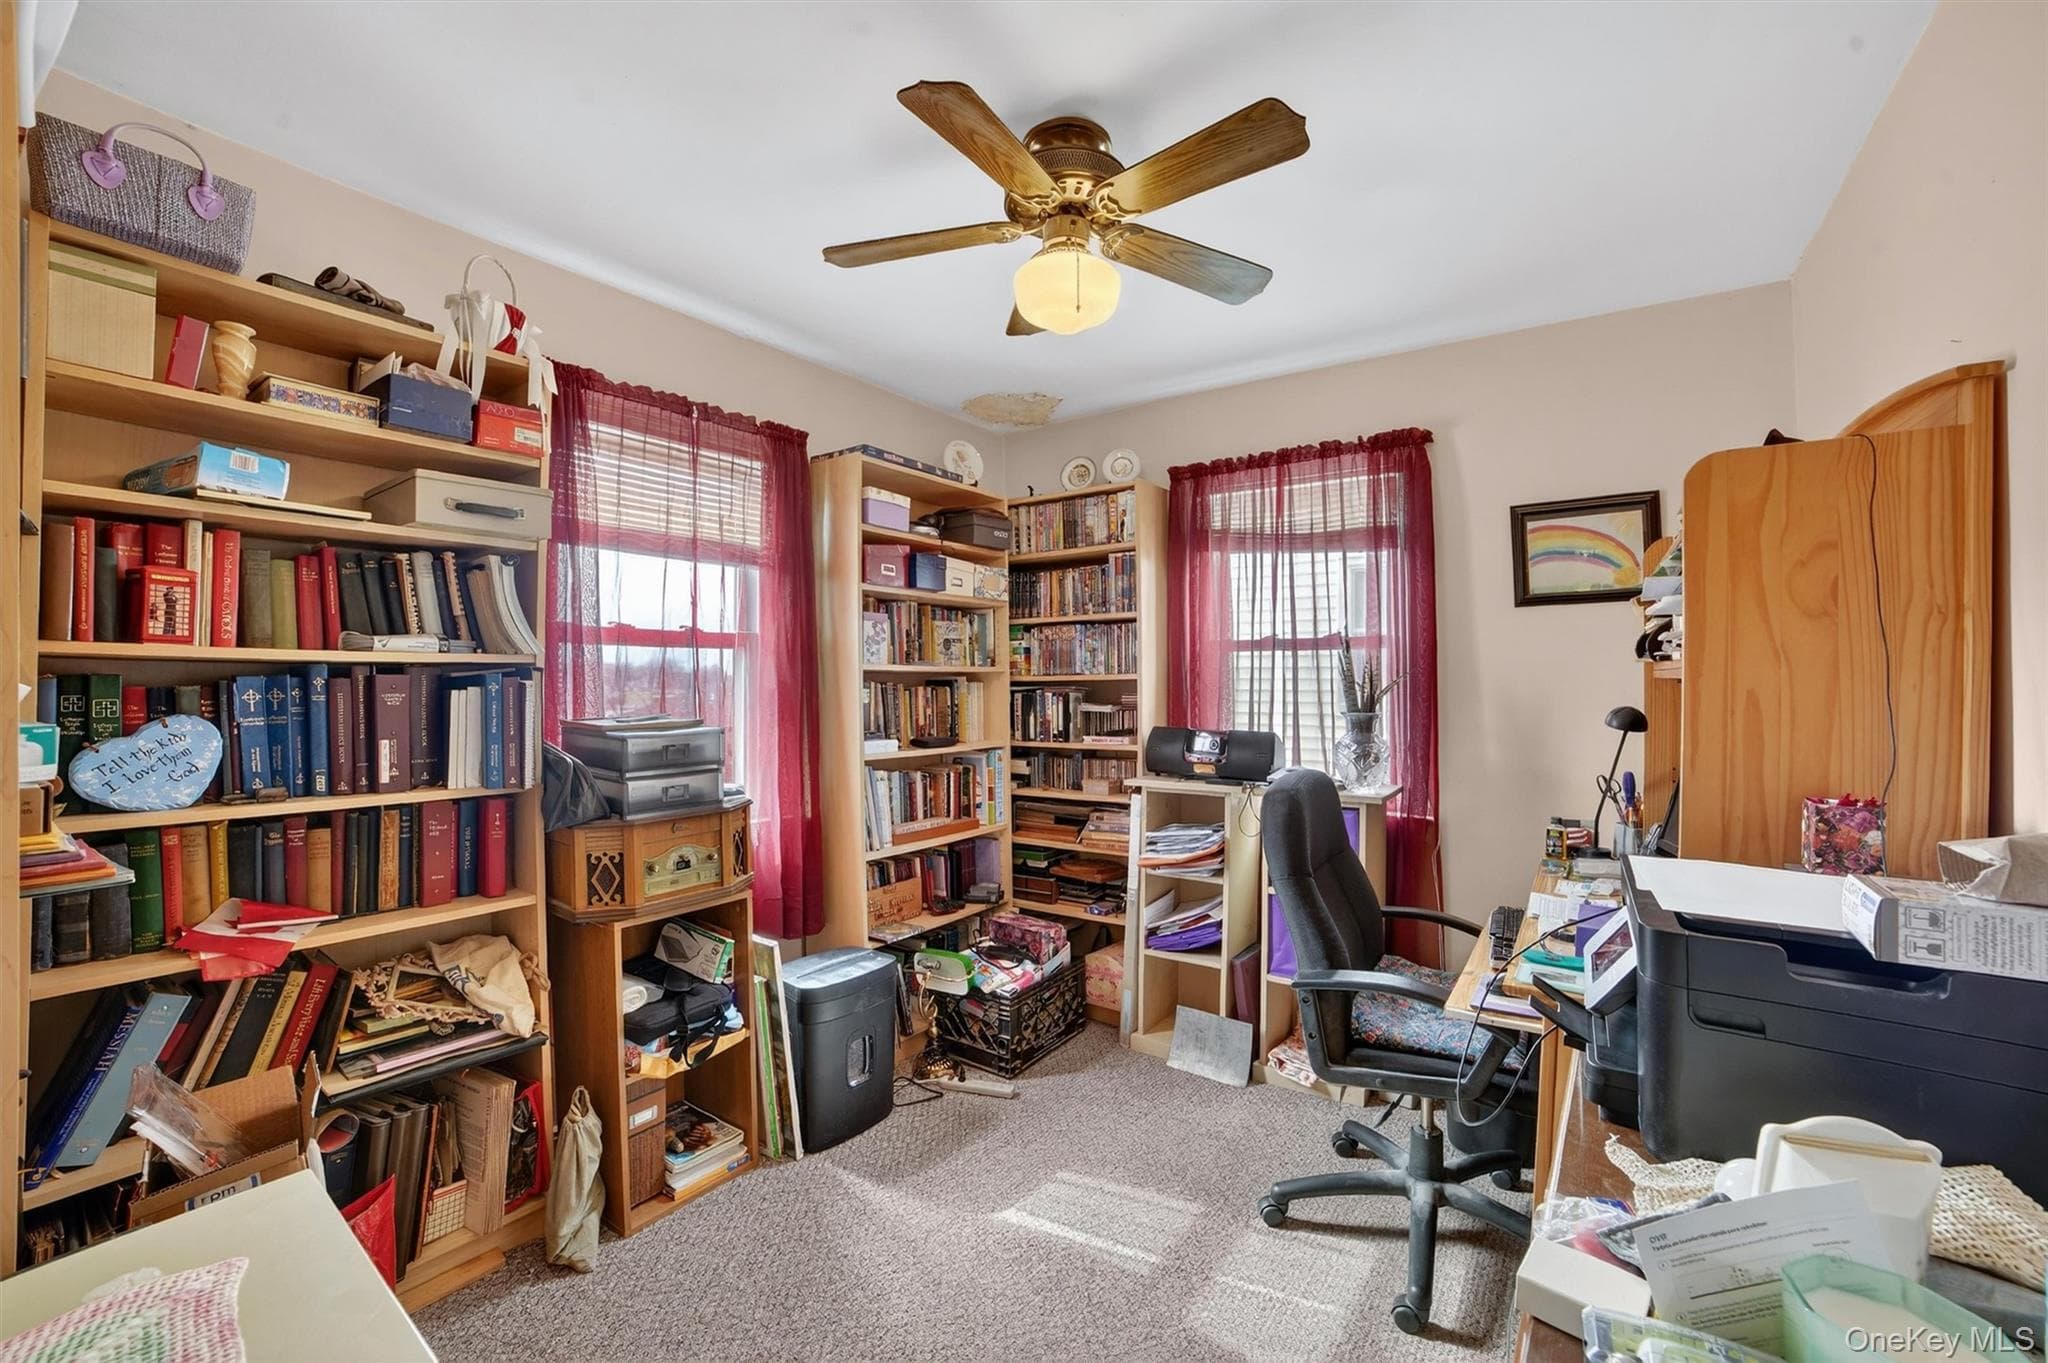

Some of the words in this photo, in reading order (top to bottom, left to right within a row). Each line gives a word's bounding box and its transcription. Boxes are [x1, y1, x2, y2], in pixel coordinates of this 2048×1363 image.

[91, 757, 129, 777] Tell
[129, 744, 158, 762] the
[102, 780, 121, 794] I
[156, 747, 193, 768] them
[94, 1006, 142, 1073] MESSIAH
